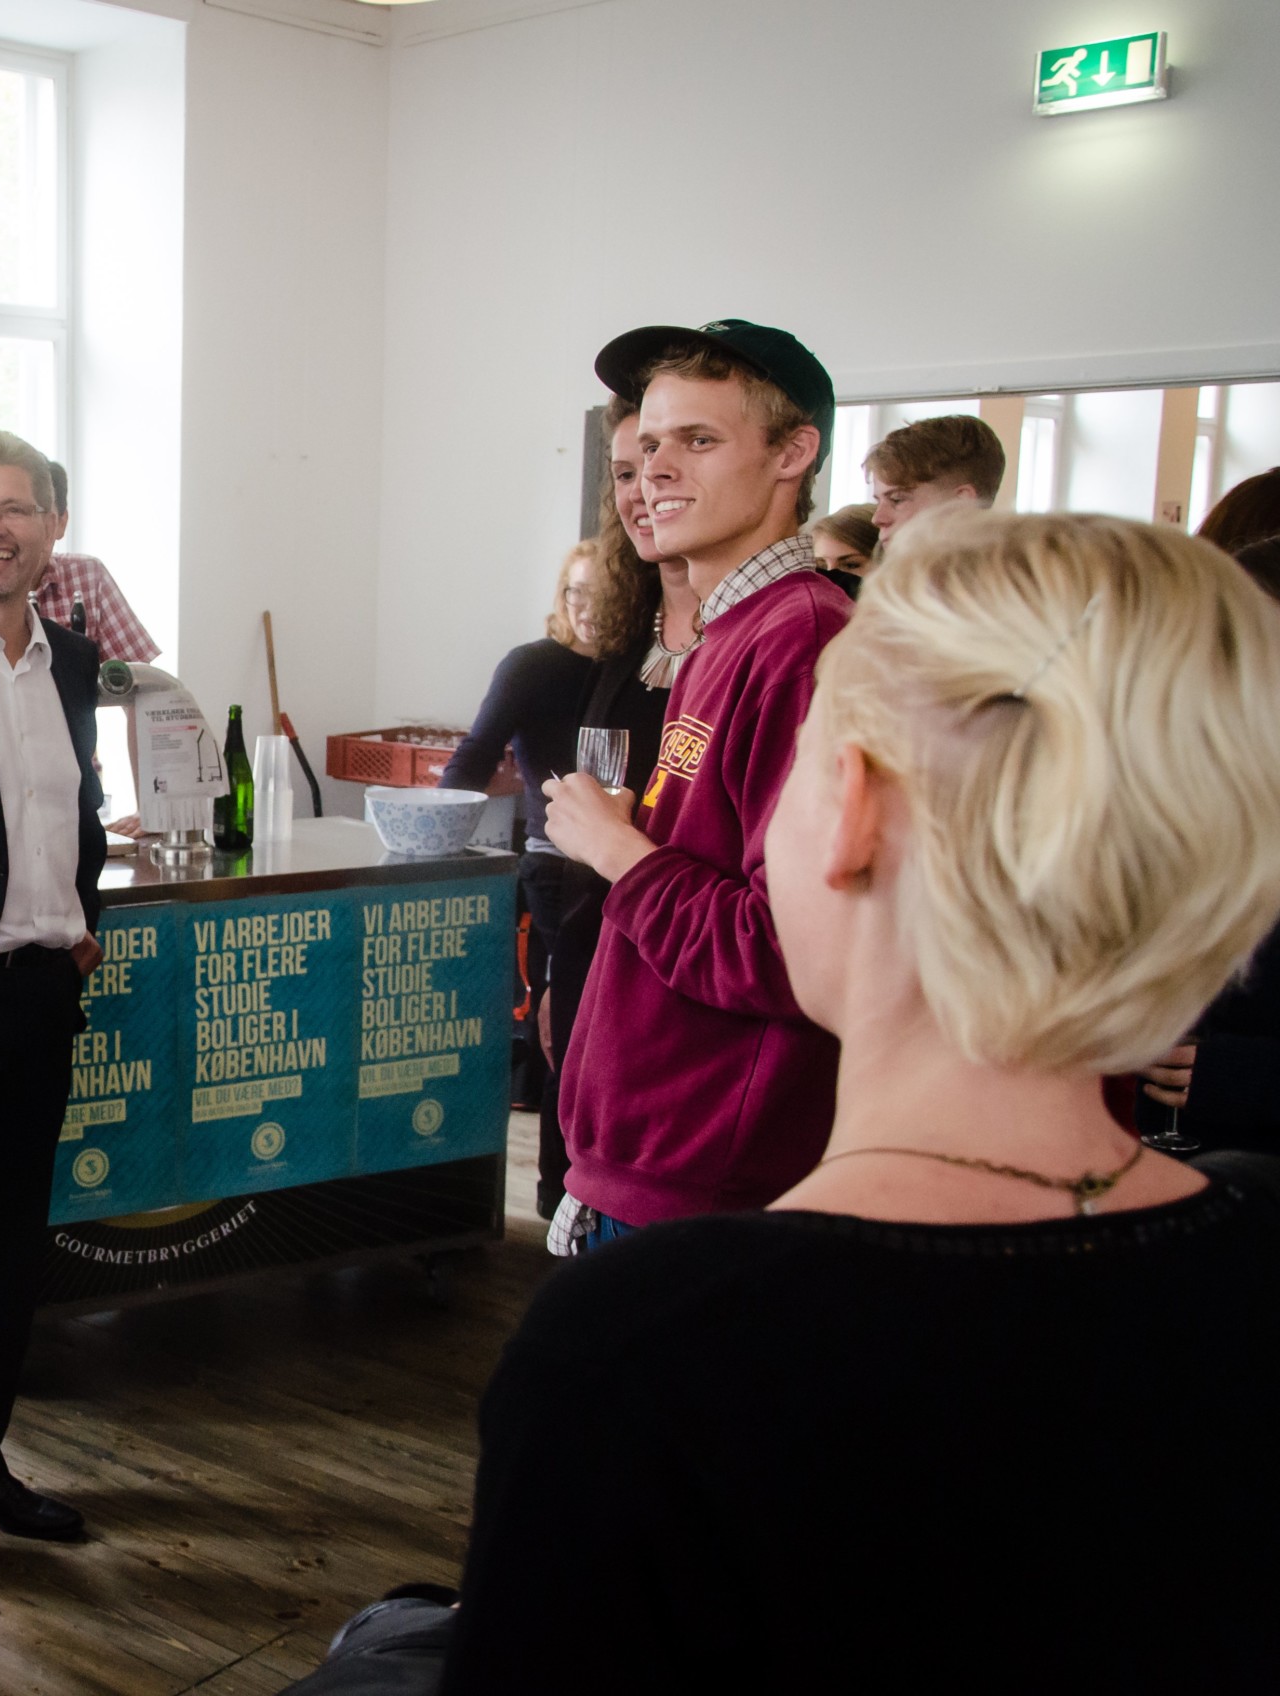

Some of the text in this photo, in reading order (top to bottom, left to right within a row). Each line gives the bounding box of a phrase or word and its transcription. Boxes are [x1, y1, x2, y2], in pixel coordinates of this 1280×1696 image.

[193, 909, 332, 953] VI ARBEJDER
[362, 894, 490, 935] VI ARBEJDER
[95, 926, 157, 962] JDER
[362, 927, 468, 967] FOR FLERE
[81, 961, 132, 998] ERE
[195, 943, 308, 987] FOR FLERE
[362, 962, 433, 998] STUDIE
[195, 980, 272, 1019] STUDIE
[361, 989, 458, 1030] BOLIGER I
[115, 1029, 121, 1061] I
[196, 1008, 299, 1052] BOLIGER I
[361, 1016, 483, 1061] KØBENHAVN
[68, 1058, 152, 1099] NHAVN
[195, 1036, 327, 1083] KØBENHAVN
[54, 1199, 259, 1265] GOURMETBRYGGERIET
